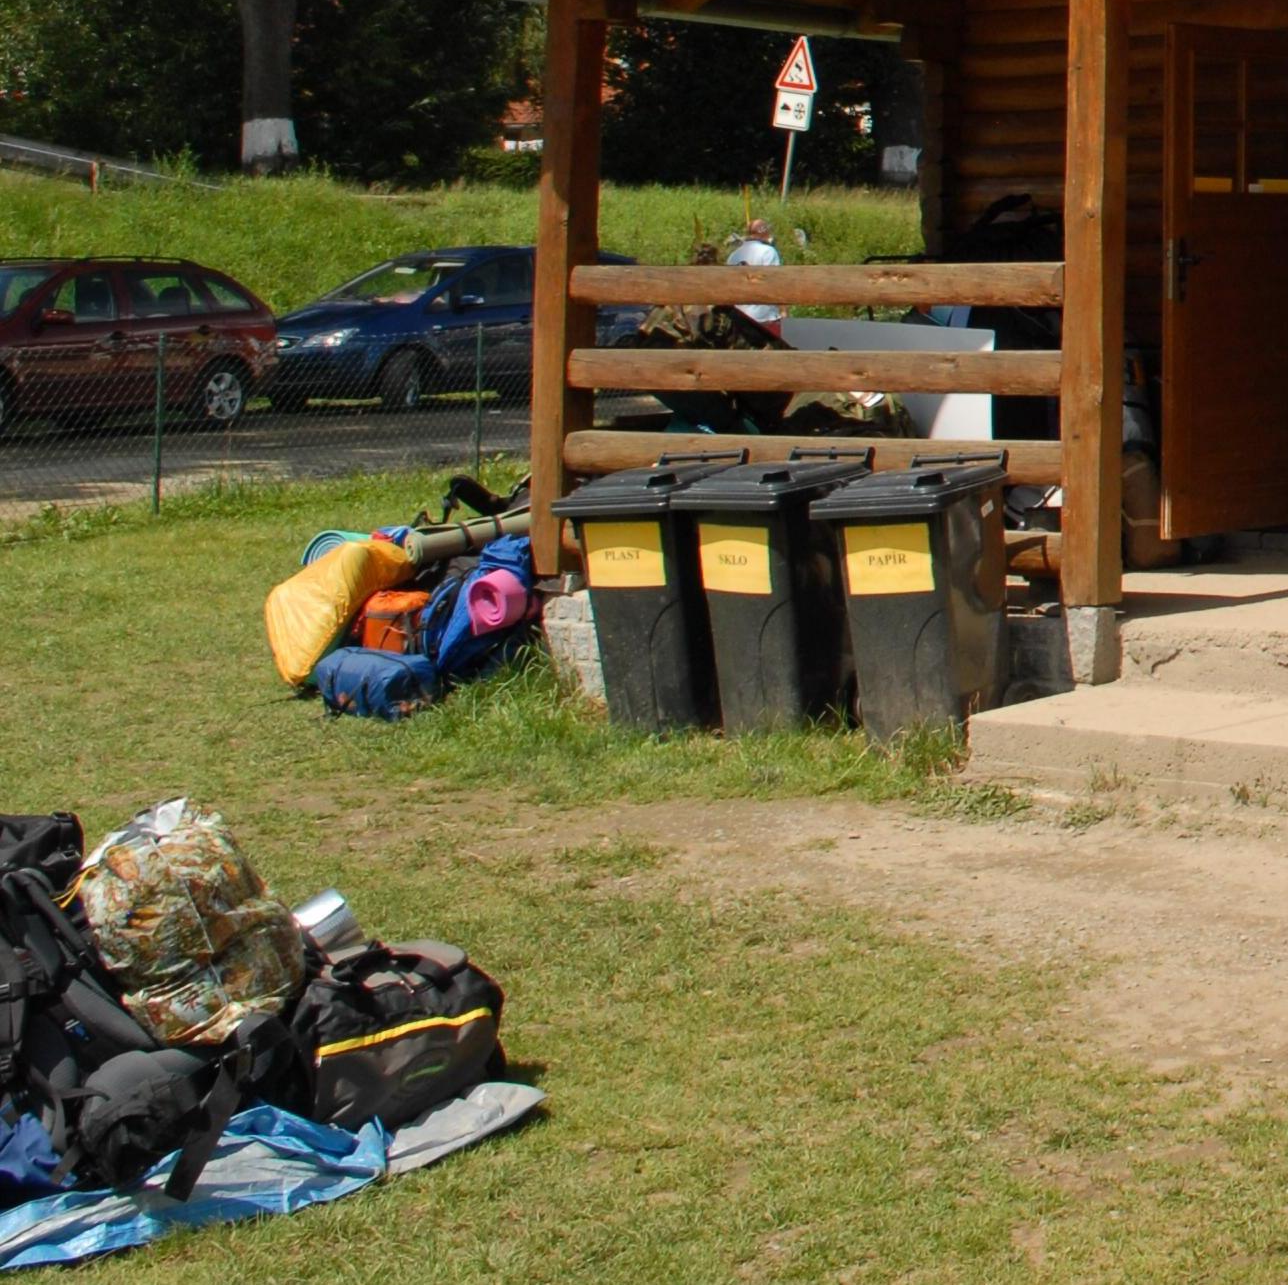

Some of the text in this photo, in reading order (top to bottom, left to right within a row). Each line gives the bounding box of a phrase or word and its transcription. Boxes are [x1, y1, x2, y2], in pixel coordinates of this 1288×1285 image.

[604, 550, 642, 562] PLAST
[719, 553, 747, 565] SKLO
[868, 552, 907, 566] PAPÍR
